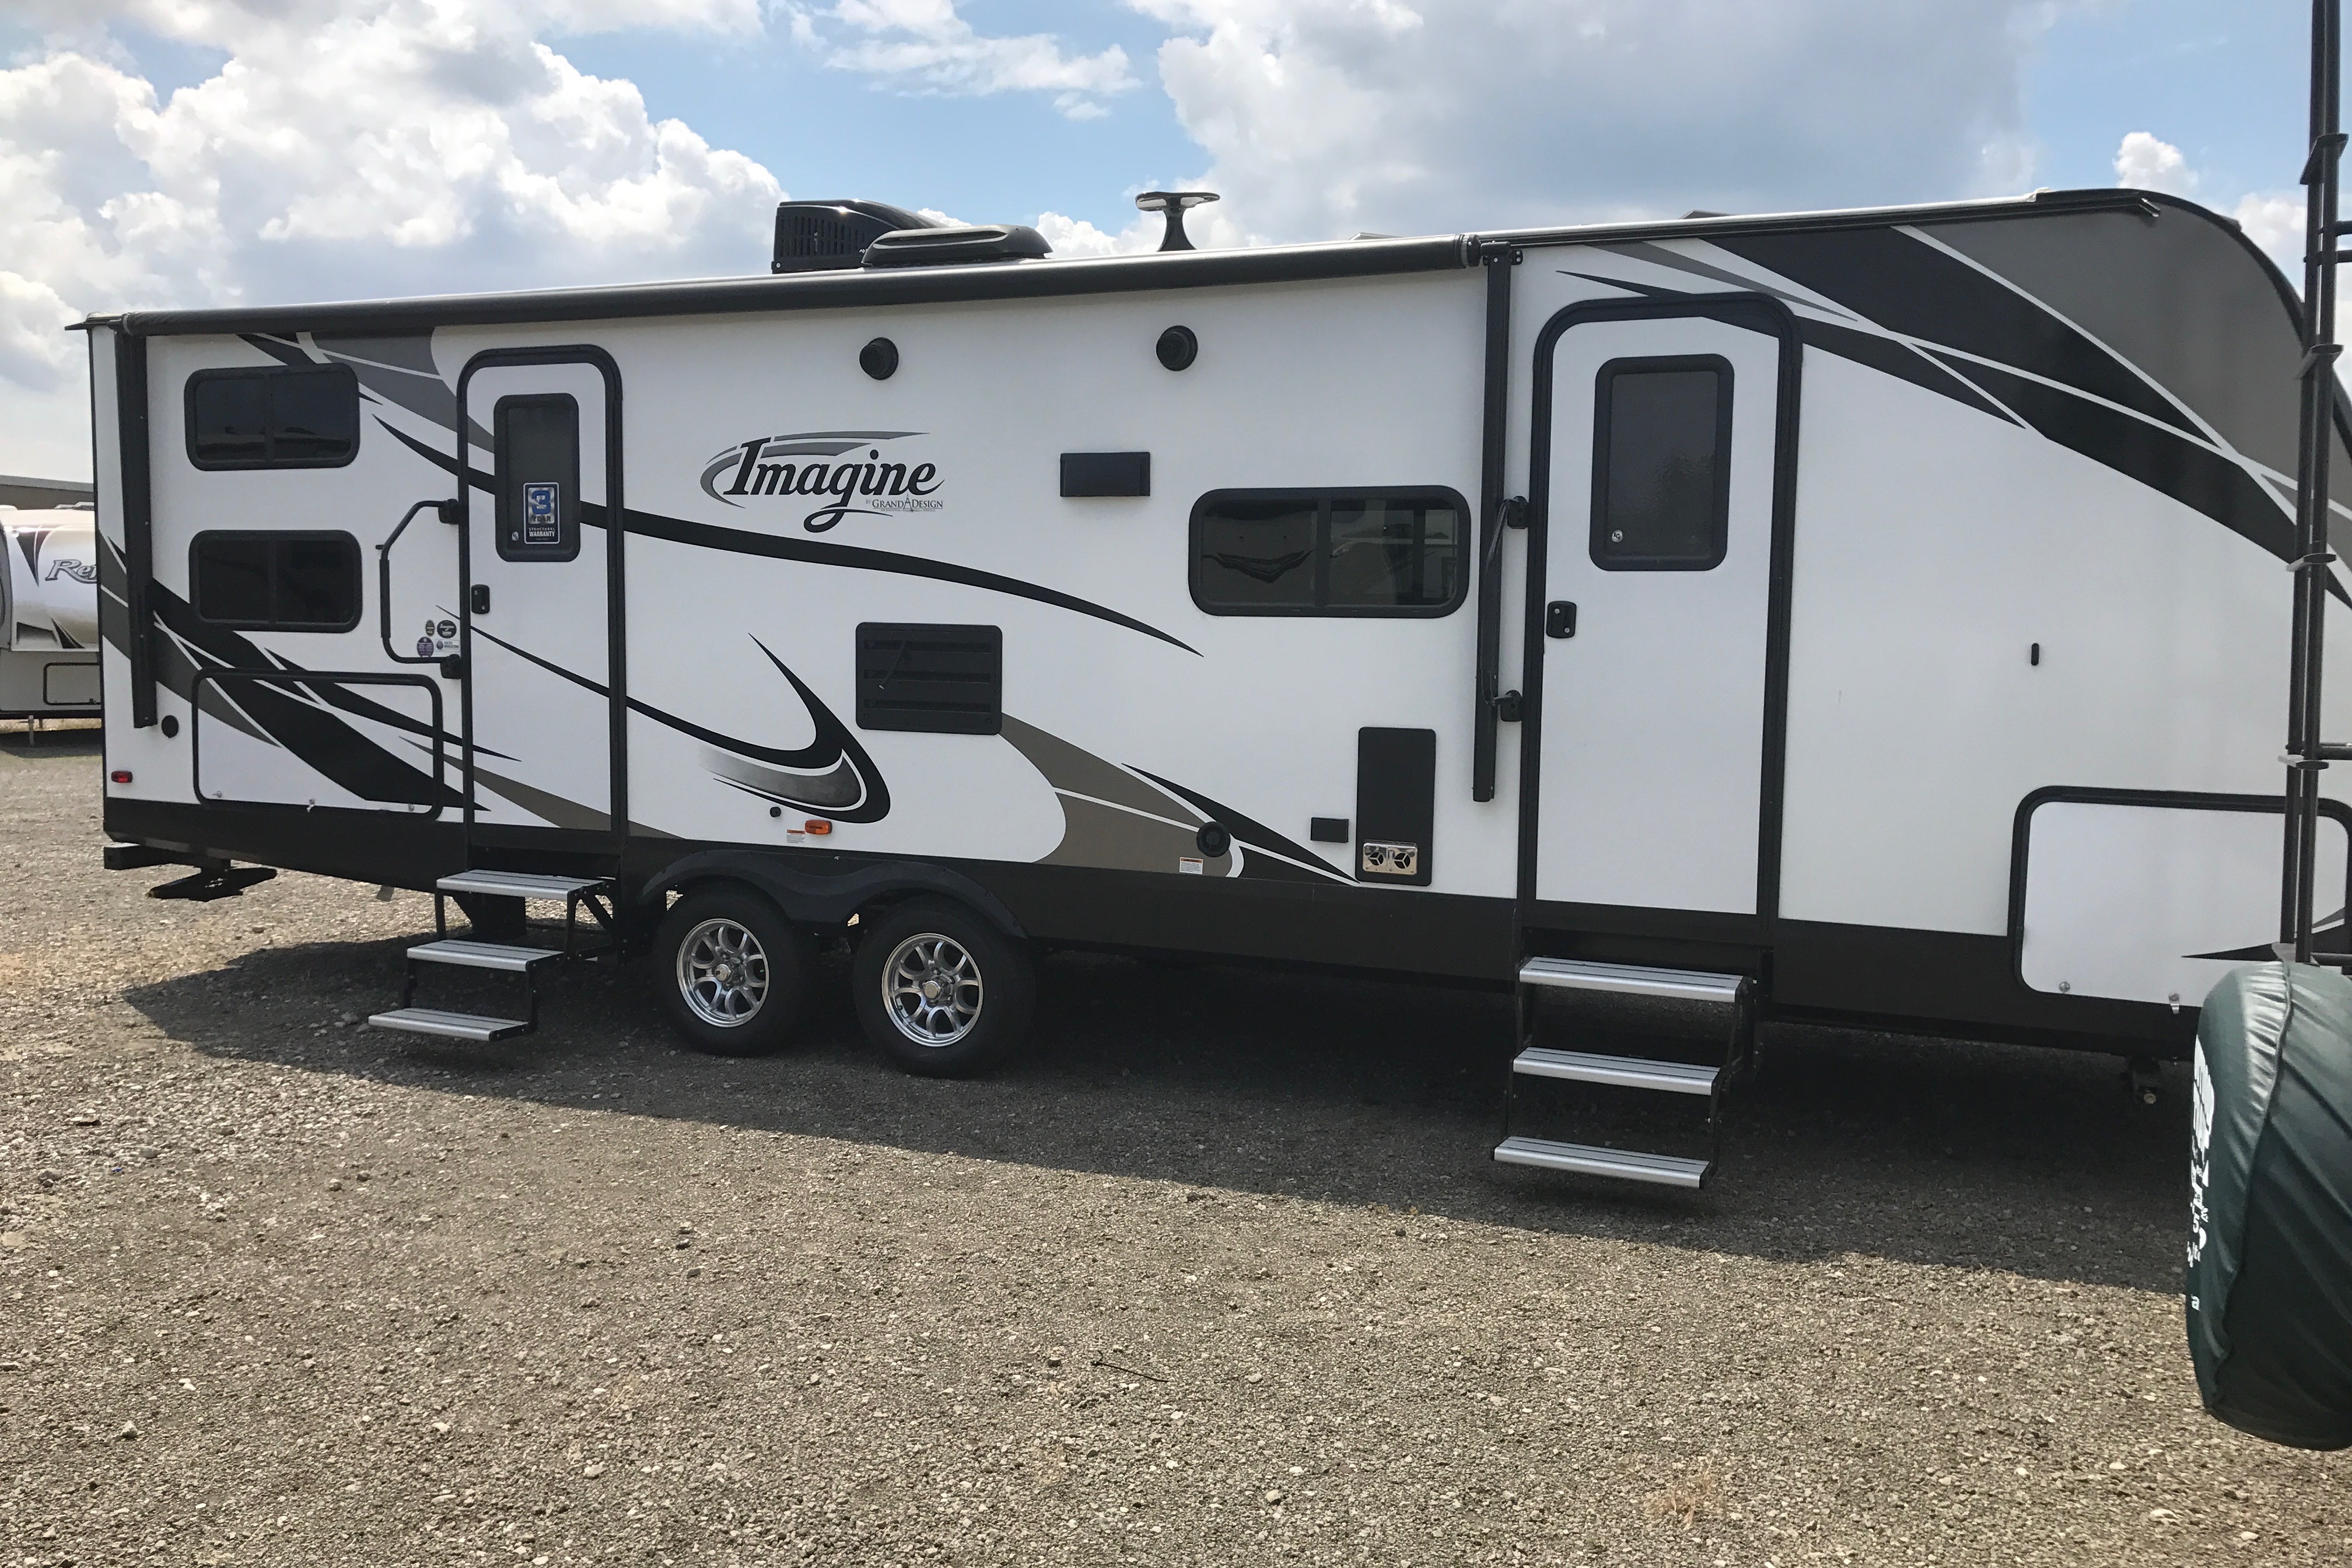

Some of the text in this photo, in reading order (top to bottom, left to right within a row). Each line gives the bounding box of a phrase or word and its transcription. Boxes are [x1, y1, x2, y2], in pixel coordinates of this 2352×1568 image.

[723, 436, 946, 533] Imagine
[531, 490, 551, 514] 3
[872, 499, 904, 508] GRAND
[912, 499, 943, 508] DESIGN
